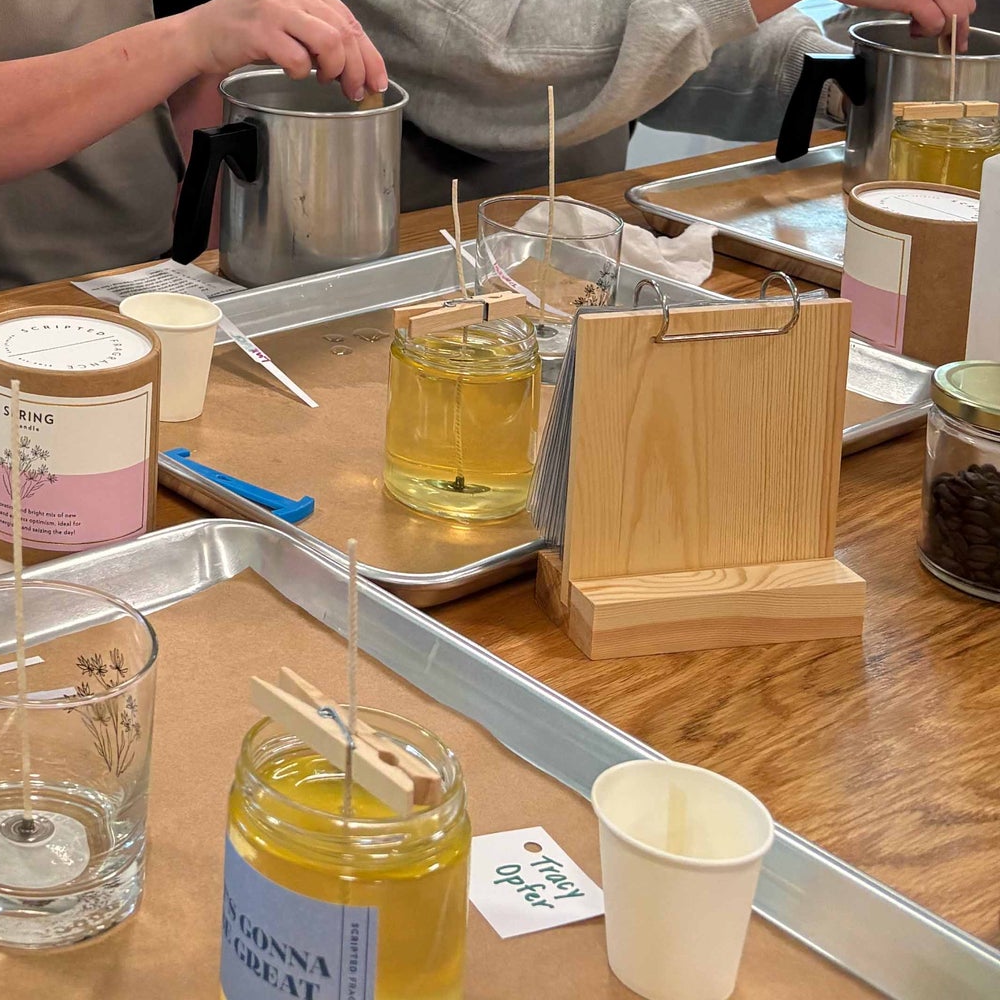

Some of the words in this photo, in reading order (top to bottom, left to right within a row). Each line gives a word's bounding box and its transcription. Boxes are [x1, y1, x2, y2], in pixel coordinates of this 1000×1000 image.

[20, 324, 106, 337] SCRIPTED
[3, 405, 55, 425] SRING
[493, 864, 555, 909] Opfer
[530, 855, 585, 900] Tracy
[233, 937, 321, 1000] GREAT
[239, 913, 332, 979] GONNA
[349, 922, 360, 972] SCRIPTED
